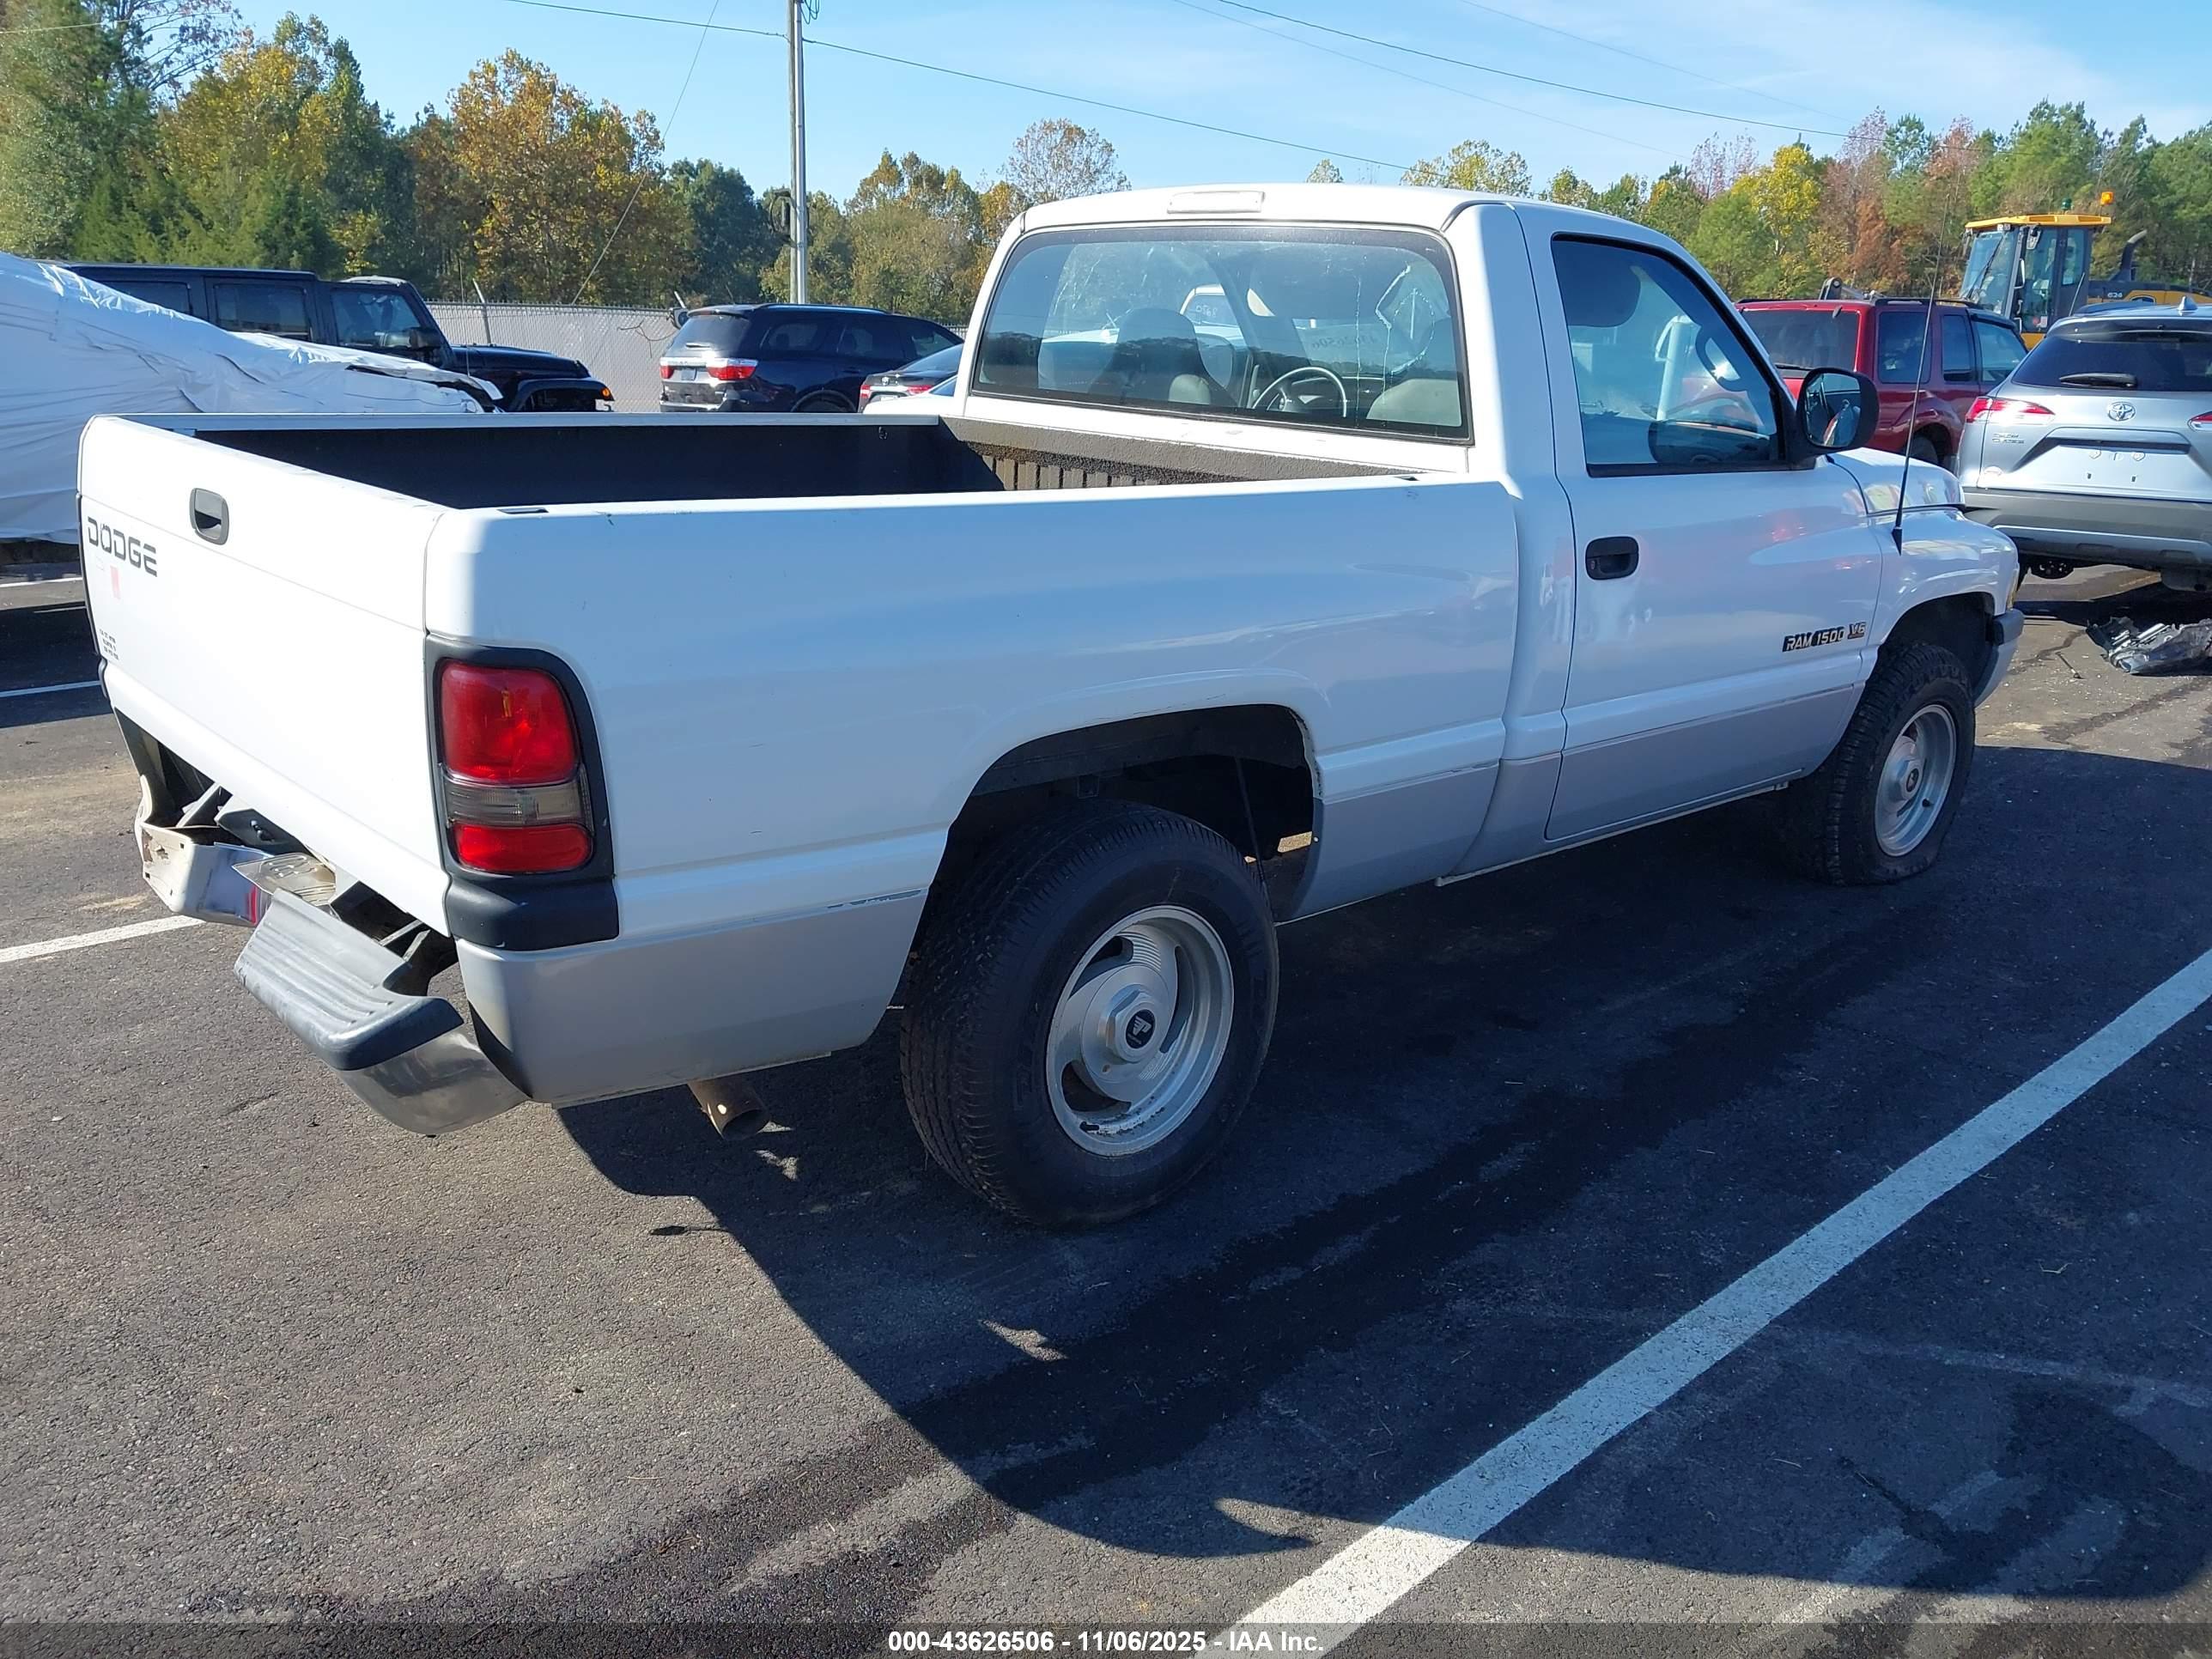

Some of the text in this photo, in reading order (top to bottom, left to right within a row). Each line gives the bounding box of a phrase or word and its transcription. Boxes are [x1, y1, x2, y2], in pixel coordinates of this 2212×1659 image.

[88, 516, 157, 578] DODGE
[1784, 622, 1866, 652] RAM 1500 V6
